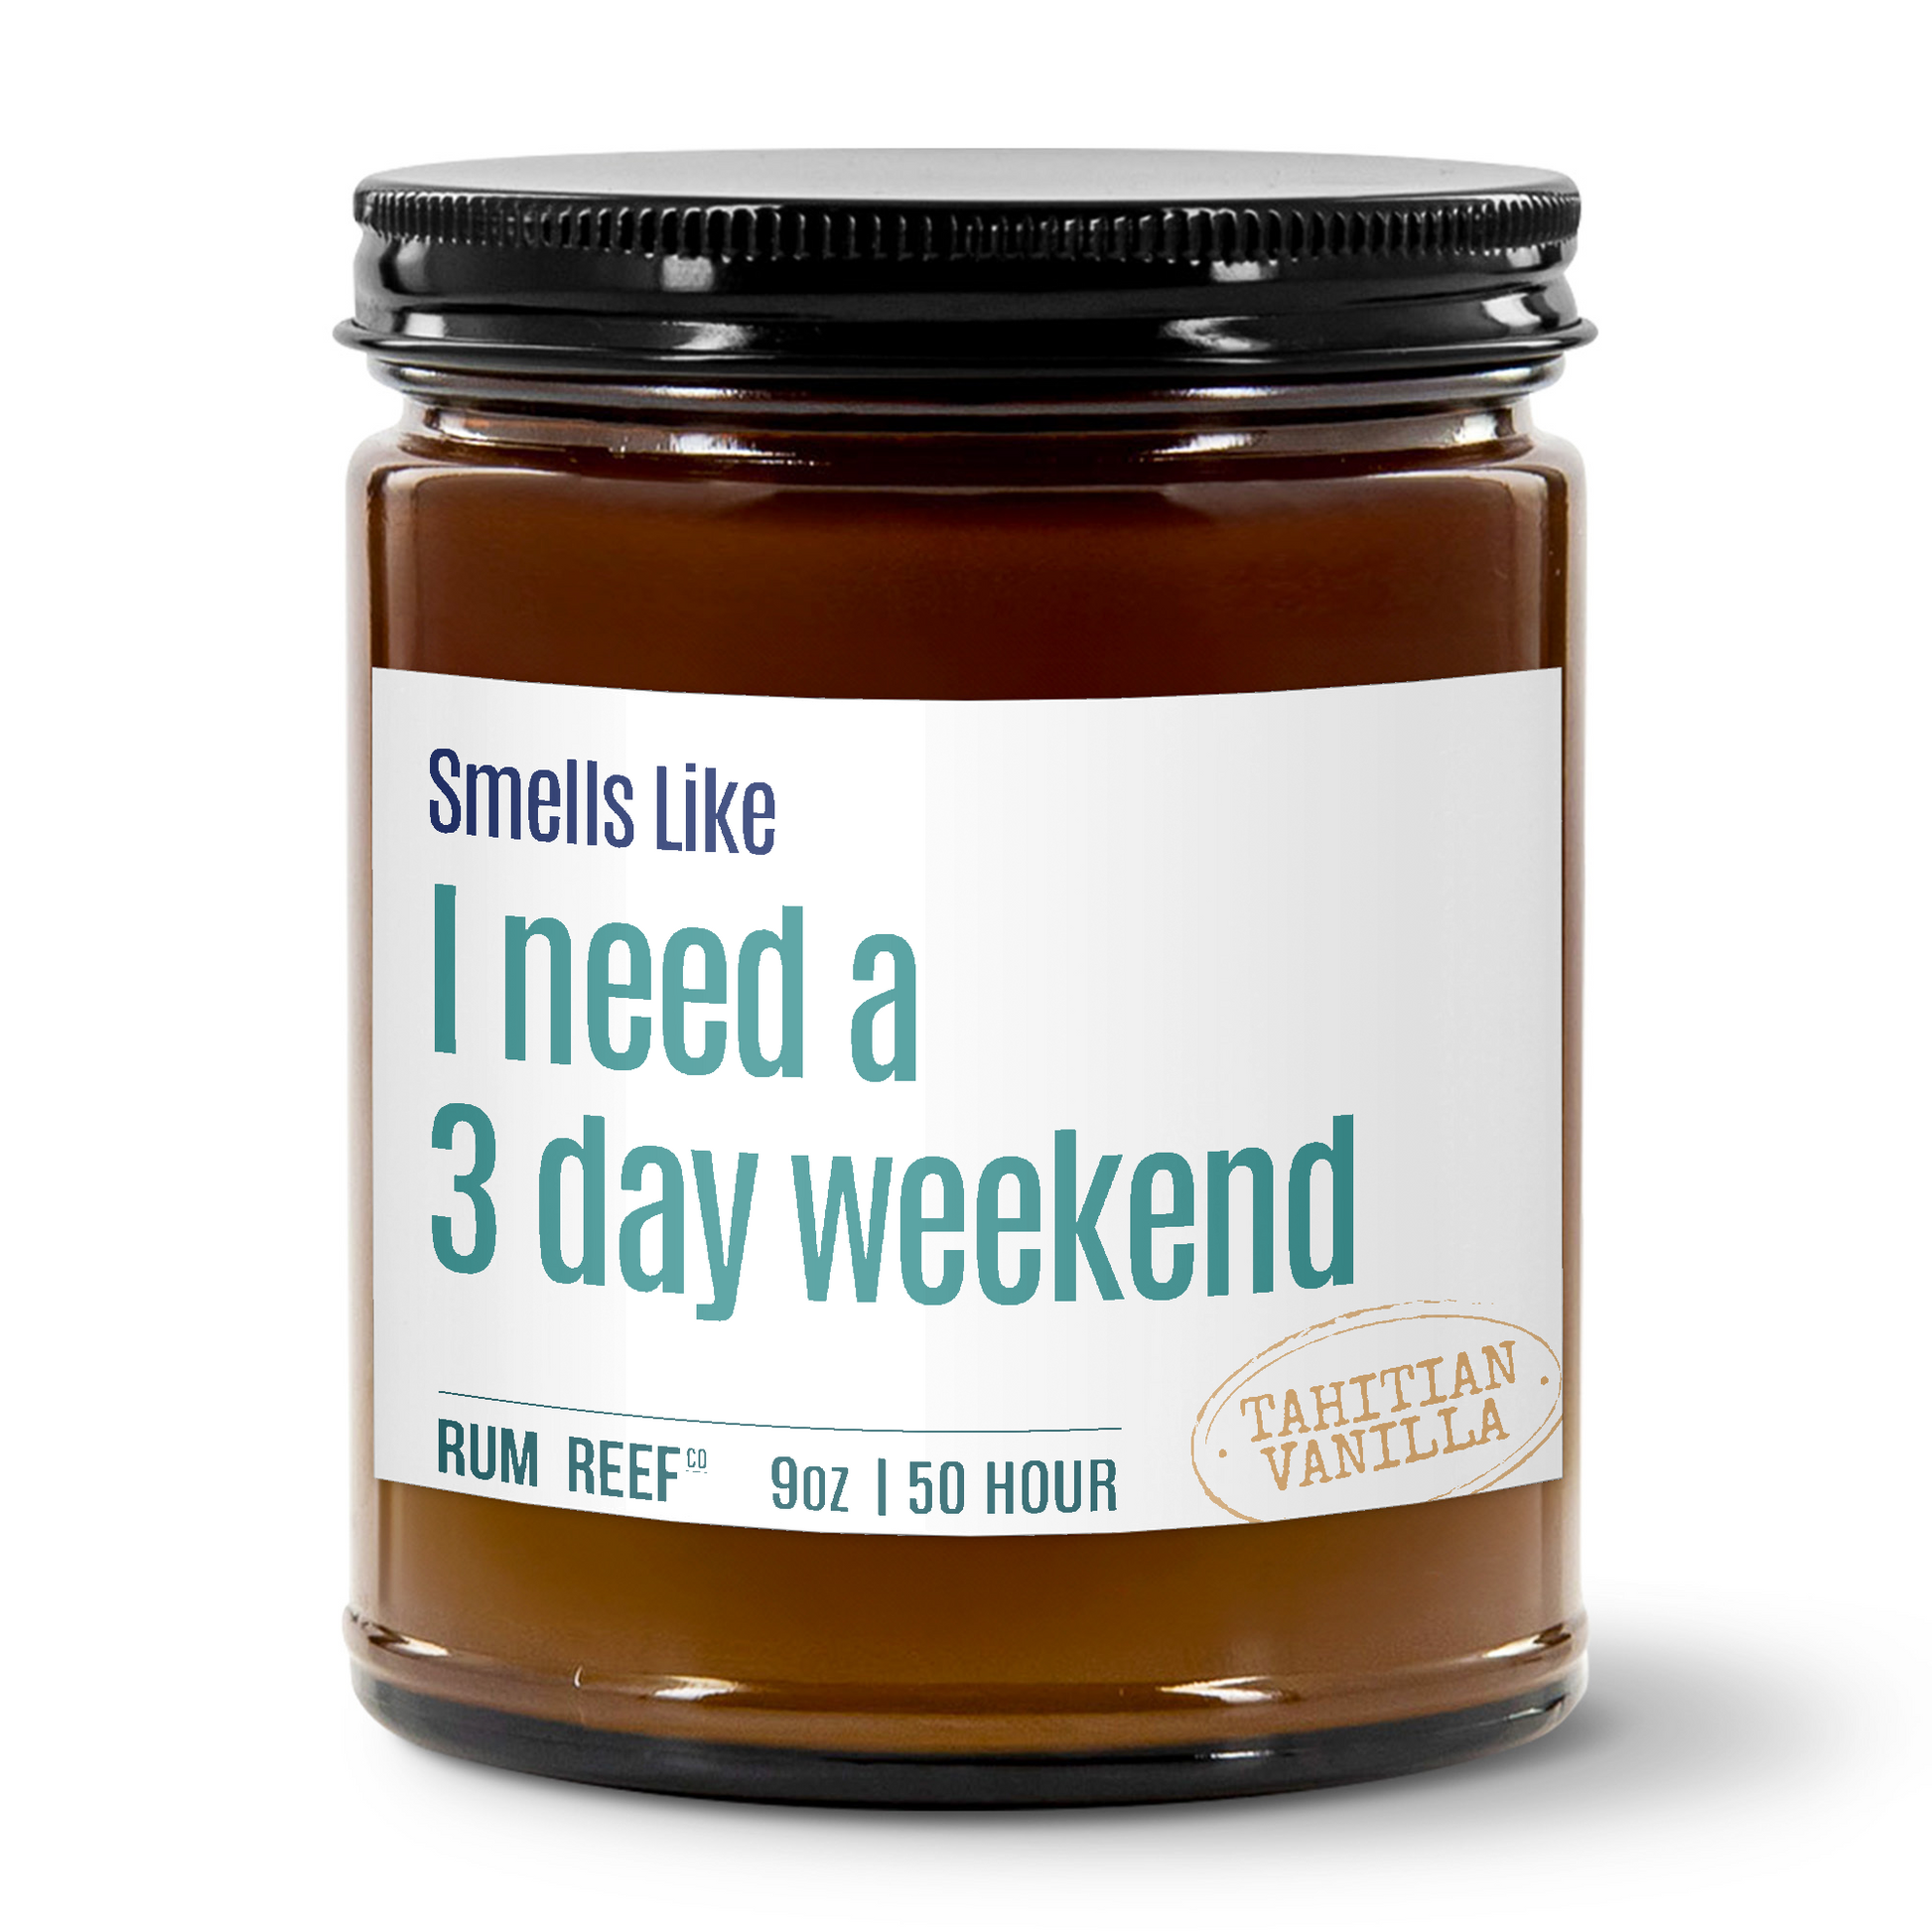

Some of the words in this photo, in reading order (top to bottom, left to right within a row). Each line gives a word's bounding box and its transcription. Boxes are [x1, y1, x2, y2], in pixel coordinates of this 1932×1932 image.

[429, 748, 634, 849] Smells
[656, 762, 775, 856] Like
[434, 883, 457, 1055] I
[504, 904, 804, 1079] need
[850, 933, 916, 1083] a
[431, 1102, 497, 1275] 3
[538, 1114, 759, 1322] day
[790, 1113, 1354, 1307] weekend
[1239, 1339, 1516, 1443] TAHITIAN
[438, 1418, 538, 1487] RUM
[568, 1436, 681, 1502] REEF
[909, 1460, 965, 1515] 50
[987, 1457, 1118, 1515] HOUR
[1259, 1397, 1511, 1491] VANILLA
